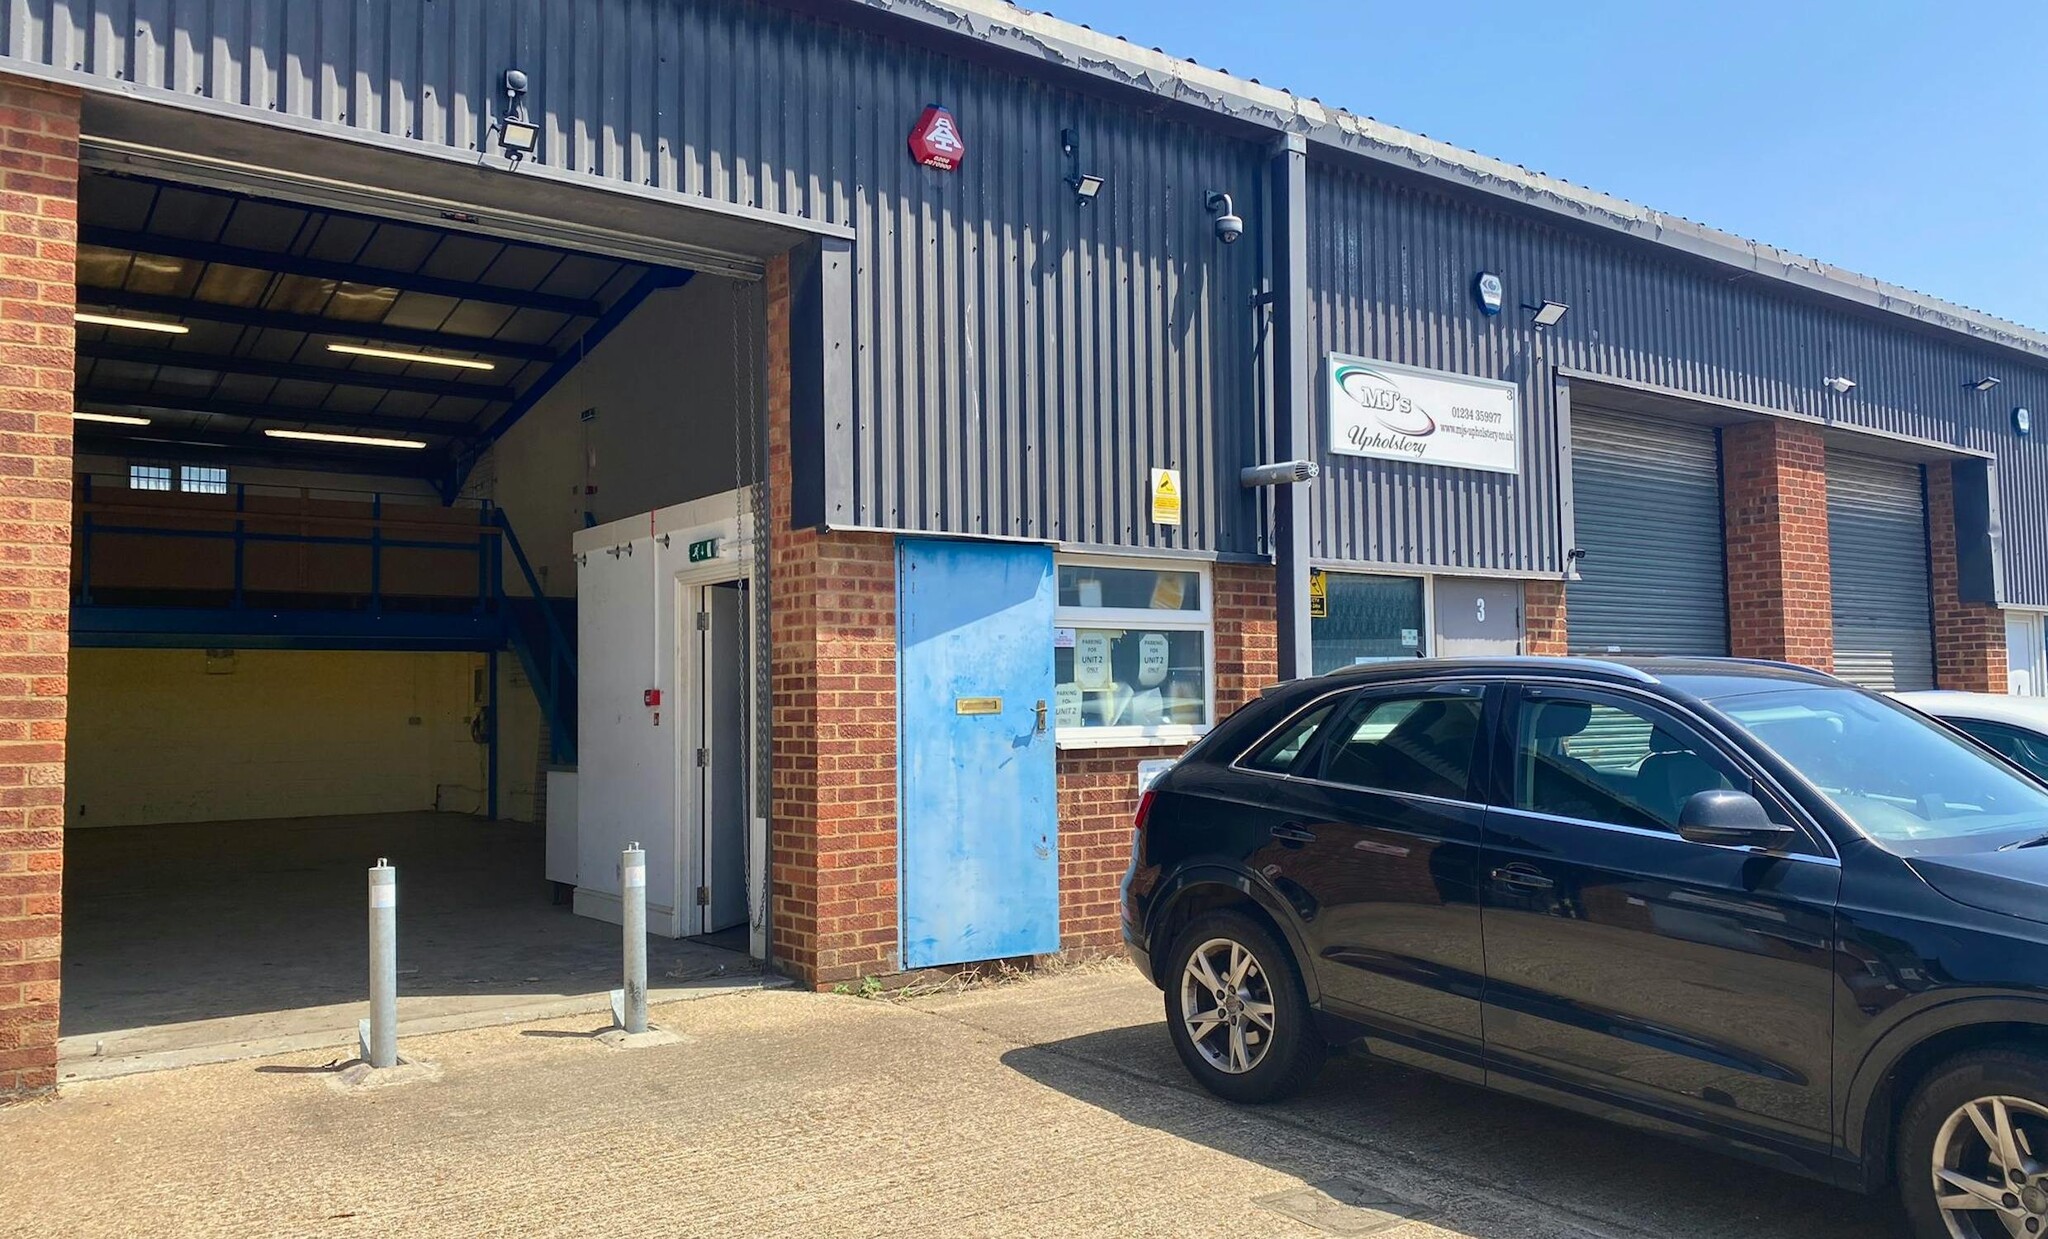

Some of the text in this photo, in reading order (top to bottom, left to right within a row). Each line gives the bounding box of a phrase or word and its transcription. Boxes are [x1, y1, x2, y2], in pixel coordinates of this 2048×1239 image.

[1506, 390, 1513, 401] 3
[1452, 406, 1502, 424] 01234 359977
[1347, 425, 1427, 459] Upholstery
[1476, 598, 1486, 622] 3
[1082, 656, 1103, 664] UNIT 2
[1144, 656, 1164, 664] UNIT 2
[1056, 707, 1077, 715] UNIT 2
